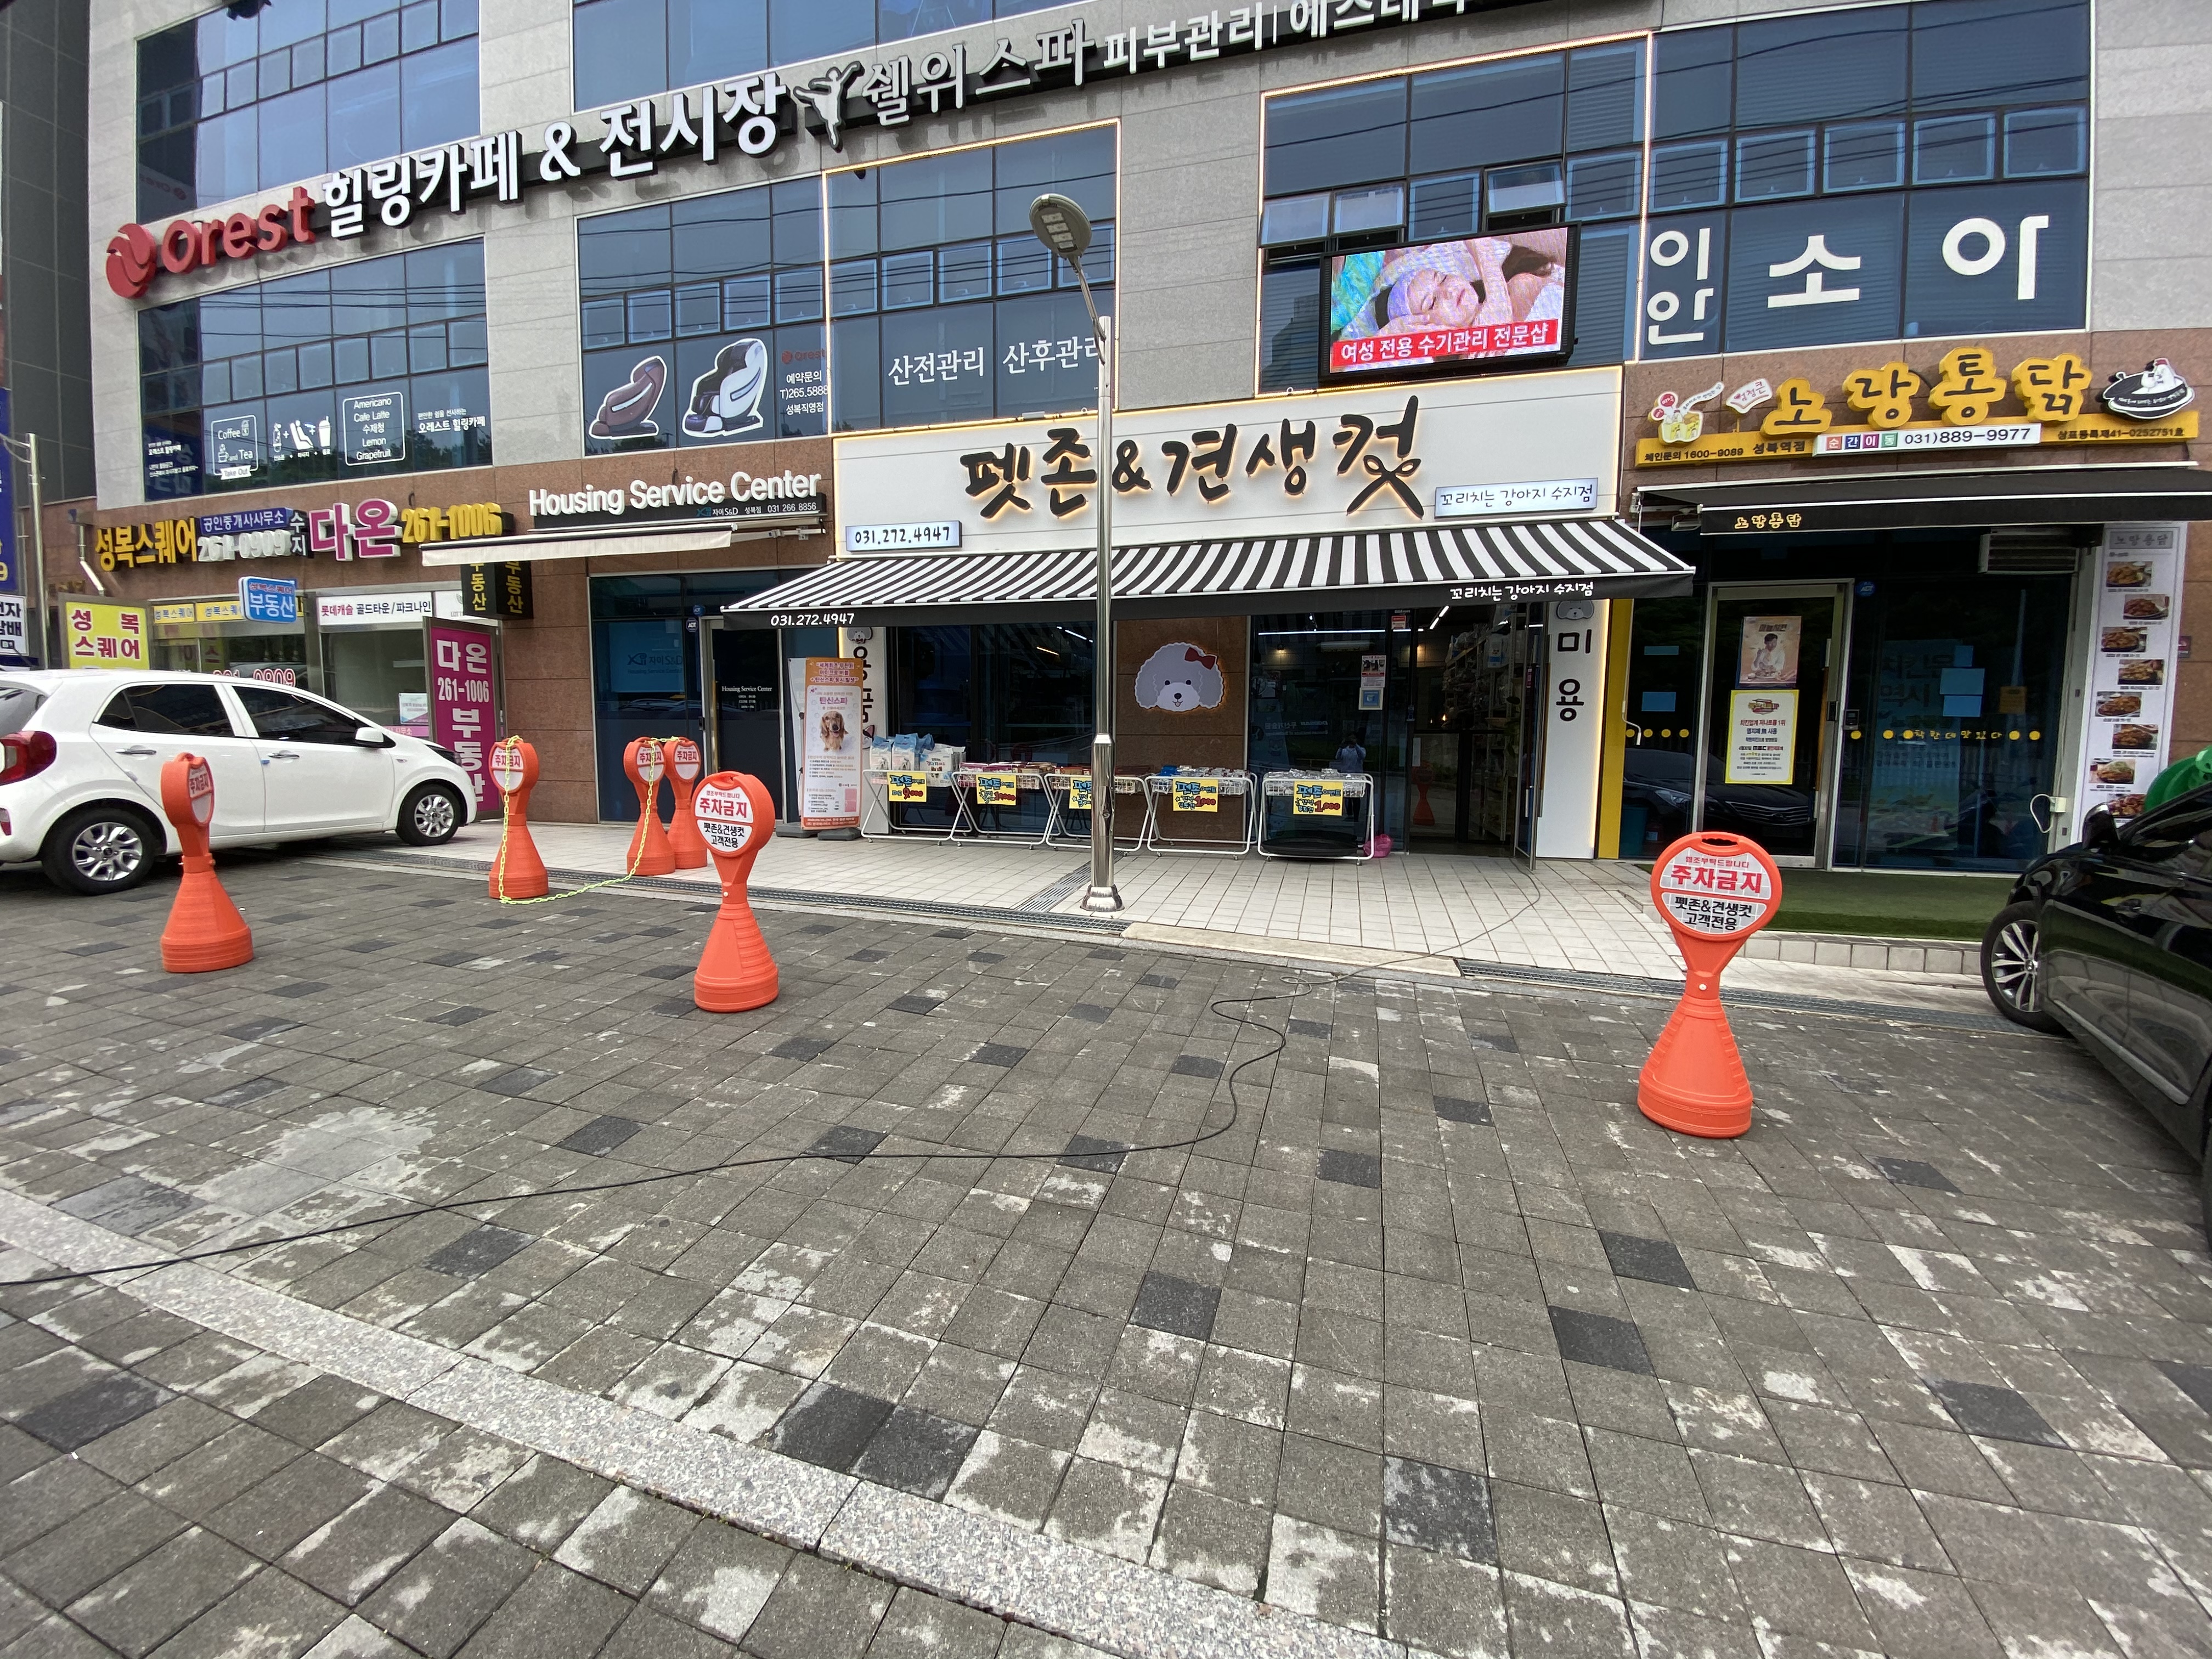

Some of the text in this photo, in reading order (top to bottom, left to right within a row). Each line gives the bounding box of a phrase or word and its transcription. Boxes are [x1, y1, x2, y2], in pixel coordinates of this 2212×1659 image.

[1103, 0, 1464, 74] 피부관리 에스
[322, 72, 790, 239] 힐링카페 & 전시장
[162, 186, 315, 274] Orest
[1341, 323, 1549, 363] 여성 전용 수기관리 전문샵
[888, 347, 984, 385] 산전관리
[786, 370, 822, 384] 예약문의
[780, 385, 828, 400] T)265.5888
[1768, 350, 2087, 429] 노랑통닭
[353, 398, 392, 410] Americano
[786, 402, 824, 415] 성복직영점
[372, 410, 390, 421] Latte
[418, 415, 486, 434] 오레스트 힐링카페
[218, 428, 241, 440] Coffee
[362, 422, 385, 434] 수제청
[362, 437, 386, 448] Lemon
[1826, 427, 2031, 452] 순간이동 031)889-9977
[239, 449, 253, 460] Tea
[356, 449, 391, 461] Grapefruit
[529, 470, 822, 517] Housing Service Center
[1441, 483, 1593, 509] 꼬리치는 강아지 수지점
[744, 506, 761, 515] 성복점
[768, 505, 779, 513] 031
[782, 504, 795, 512] 266
[798, 503, 816, 511] 8856
[203, 509, 285, 532] 공인중개사사무소
[309, 498, 402, 561] 다온
[402, 502, 503, 543] 261-1006
[95, 517, 198, 572] 성복스퀘어
[854, 526, 951, 546] 031.272.4947
[1450, 582, 1594, 602] 꼬리치는 강아지 수지점
[205, 604, 242, 617] 성복스퀘
[250, 592, 295, 618] 부동산
[321, 604, 353, 617] 롯데캐슬
[771, 613, 855, 627] 031.272.4947
[75, 637, 140, 660] 스퀘어
[437, 639, 487, 674] 다온
[1556, 629, 1593, 722] 미용
[437, 677, 490, 703] 261-1006
[640, 751, 662, 764] 주차지
[677, 751, 697, 761] 주차금지
[699, 797, 747, 819] 주차금지
[703, 822, 745, 837] 펫존&견생컷
[711, 834, 738, 849] 고객전용
[1685, 855, 1750, 868] 협조부탁드립니다
[1671, 865, 1763, 894] 주차금지
[1675, 896, 1752, 918] 펫존&견생컷
[1684, 912, 1737, 931] 고객전용
